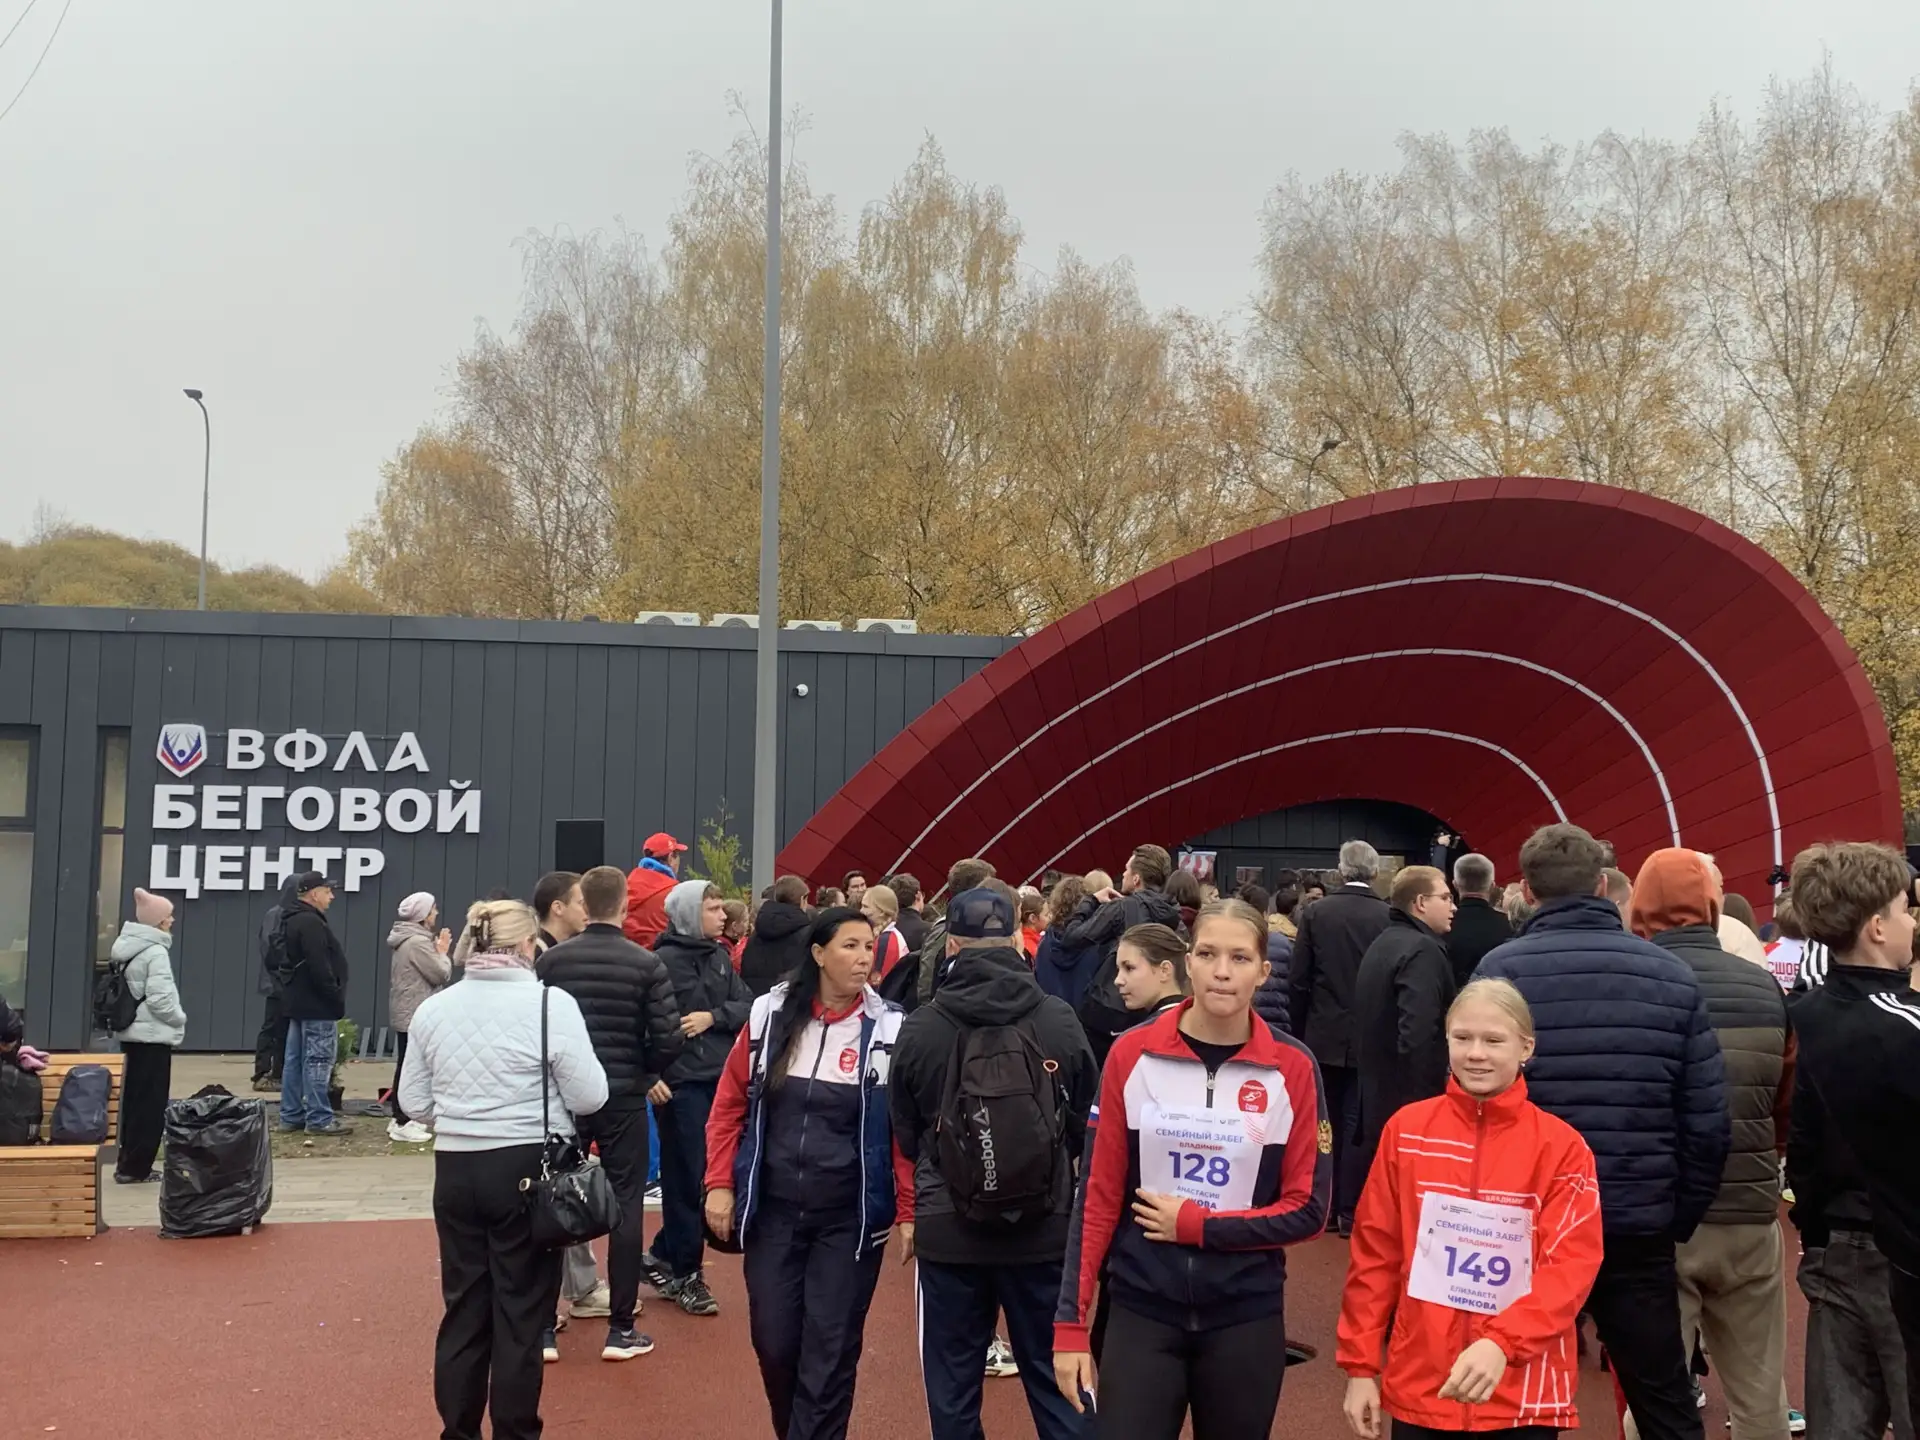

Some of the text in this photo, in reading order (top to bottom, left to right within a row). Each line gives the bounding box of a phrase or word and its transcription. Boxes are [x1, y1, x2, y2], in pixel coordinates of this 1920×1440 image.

[226, 728, 430, 772] ВФЛА
[152, 779, 481, 834] БЕГОВОЙ
[150, 844, 386, 899] ЦЕНТР
[1155, 1127, 1245, 1144] СЕМЕЙНЫЙ ЗАБЕГ
[1179, 1141, 1224, 1151] ВЛАДИМИР
[978, 1127, 998, 1192] Reebok
[1168, 1150, 1231, 1187] 128
[1176, 1184, 1221, 1200] АНАСТАСИЯ
[1435, 1218, 1493, 1238] СЕМЕЙНЫЙ
[1495, 1231, 1525, 1243] ЗАБЕГ
[1457, 1235, 1504, 1250] ВЛАДИМИР
[1444, 1245, 1511, 1287] 149
[1447, 1294, 1498, 1312] ЧИРКОВА
[1449, 1284, 1498, 1301] ЕЛИЗАВЕТА
